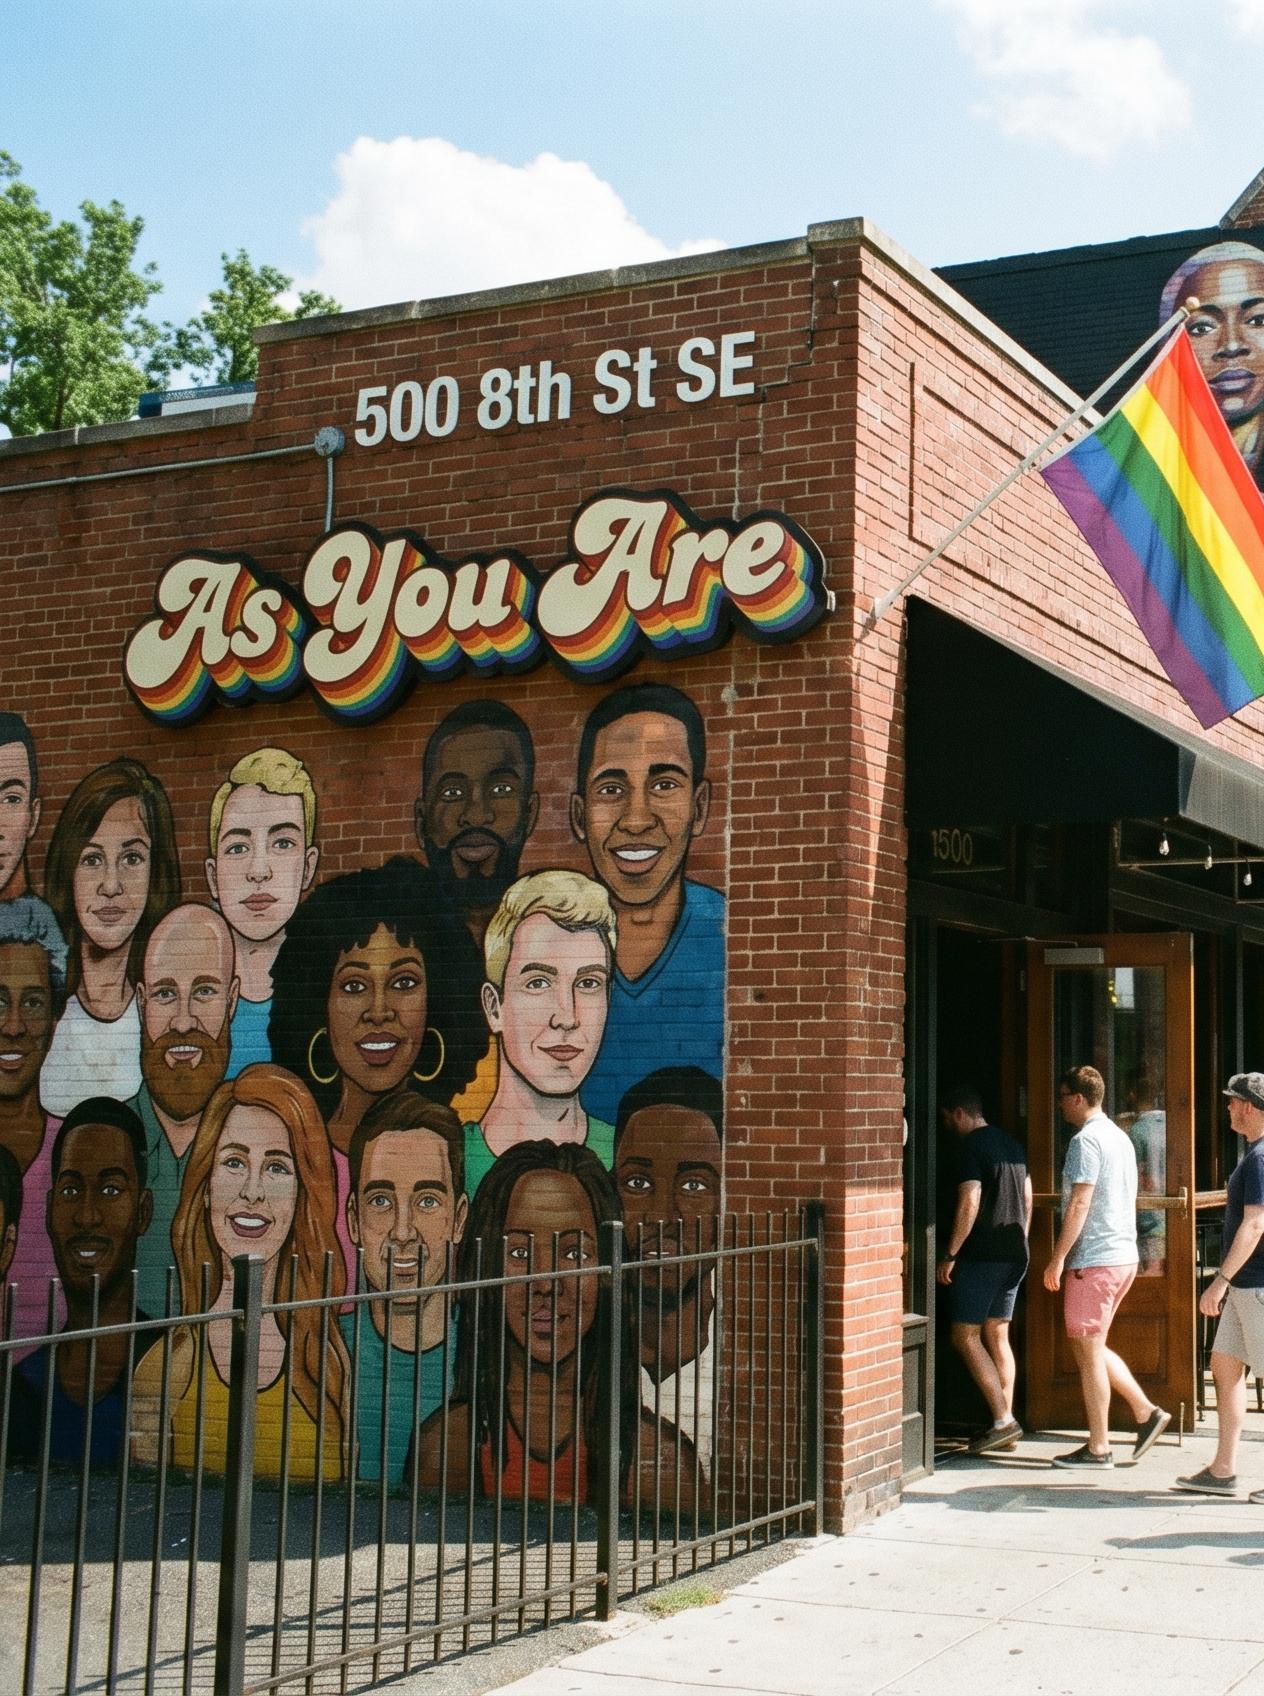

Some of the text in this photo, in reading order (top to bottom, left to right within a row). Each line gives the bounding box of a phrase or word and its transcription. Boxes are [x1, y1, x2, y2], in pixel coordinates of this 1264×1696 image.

[354, 330, 756, 447] 500 8th St SE
[125, 497, 788, 691] As You Are
[931, 828, 974, 866] 1500
